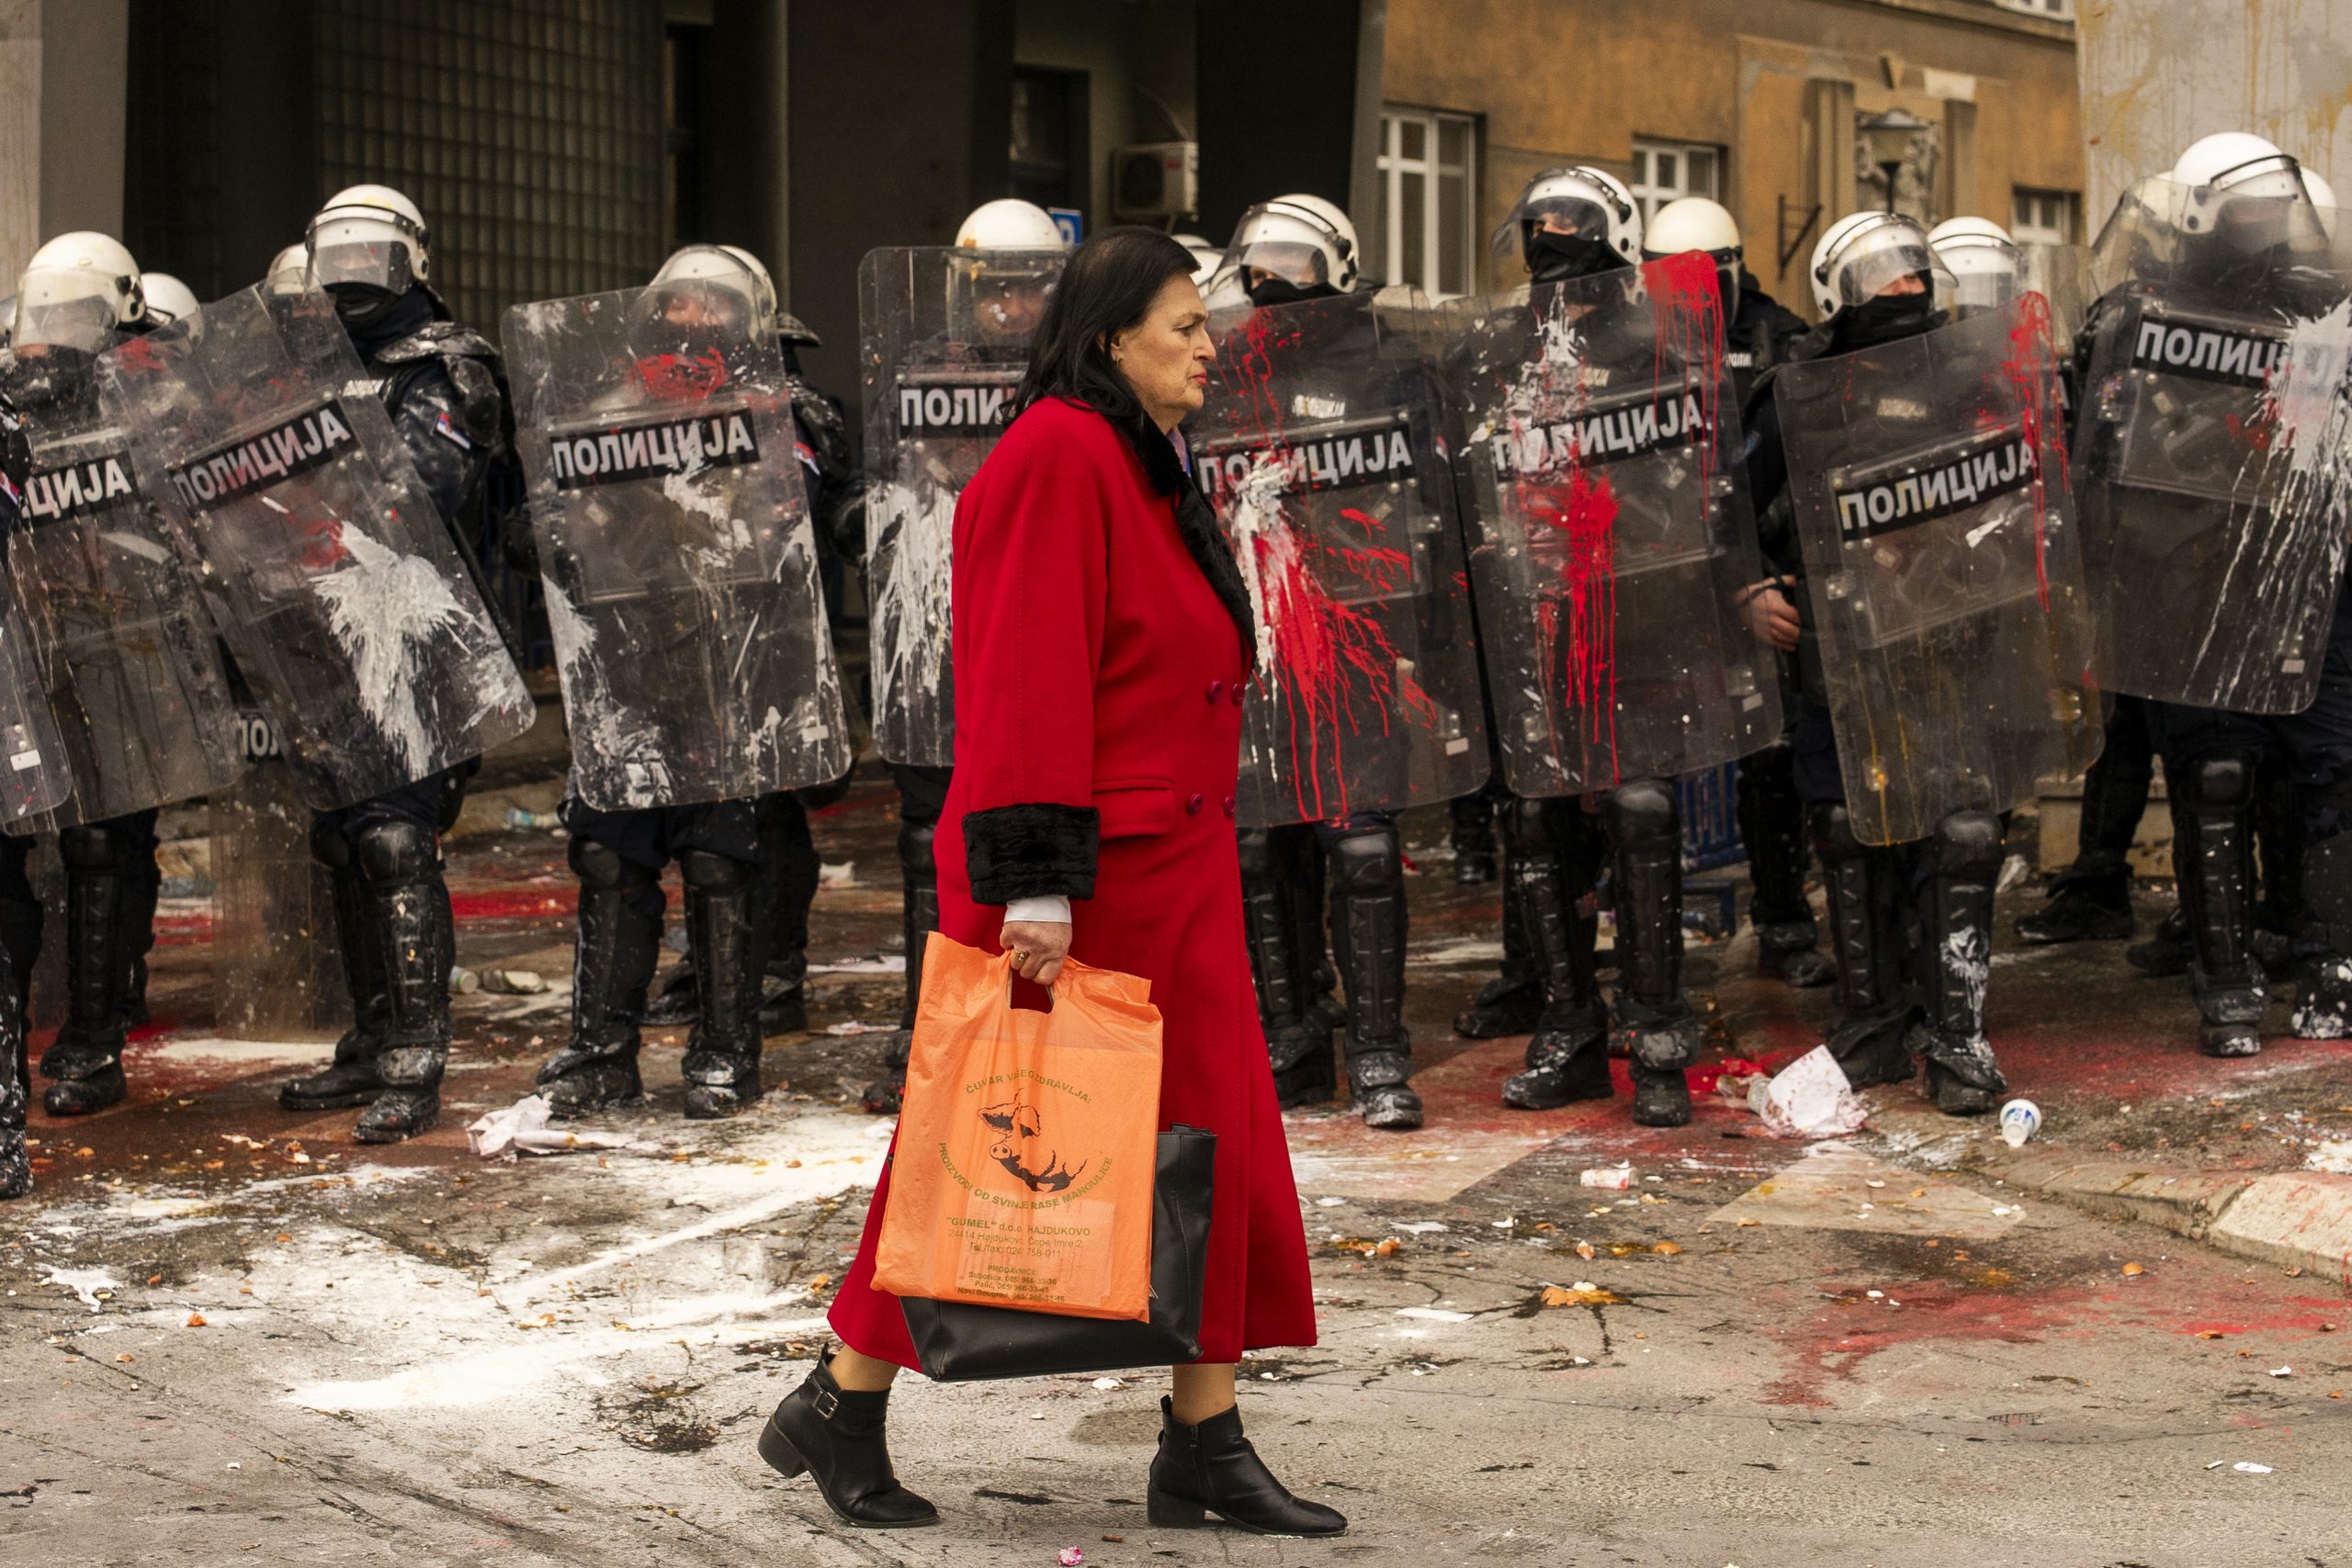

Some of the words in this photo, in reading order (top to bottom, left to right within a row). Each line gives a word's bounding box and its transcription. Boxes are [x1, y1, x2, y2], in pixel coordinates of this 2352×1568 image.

[900, 388, 1015, 426] ПОЛИ
[173, 408, 352, 508] ПОЛИЦИЈА
[552, 415, 754, 479] ПОЛИЦИЈА
[1198, 431, 1413, 494] ПОИЦИЈА
[21, 458, 132, 519] ЦИЈА
[1838, 440, 2038, 530] ПОЛИЦИЈА
[966, 1076, 1003, 1094] ČUVAR
[939, 1143, 973, 1191] PROIZVODI
[974, 1189, 989, 1201] OD
[992, 1196, 1029, 1210] SVINJE
[1031, 1198, 1059, 1210] RASE
[1062, 1156, 1114, 1204] MANGULICE
[1028, 1224, 1091, 1236] HAJDUKOVO
